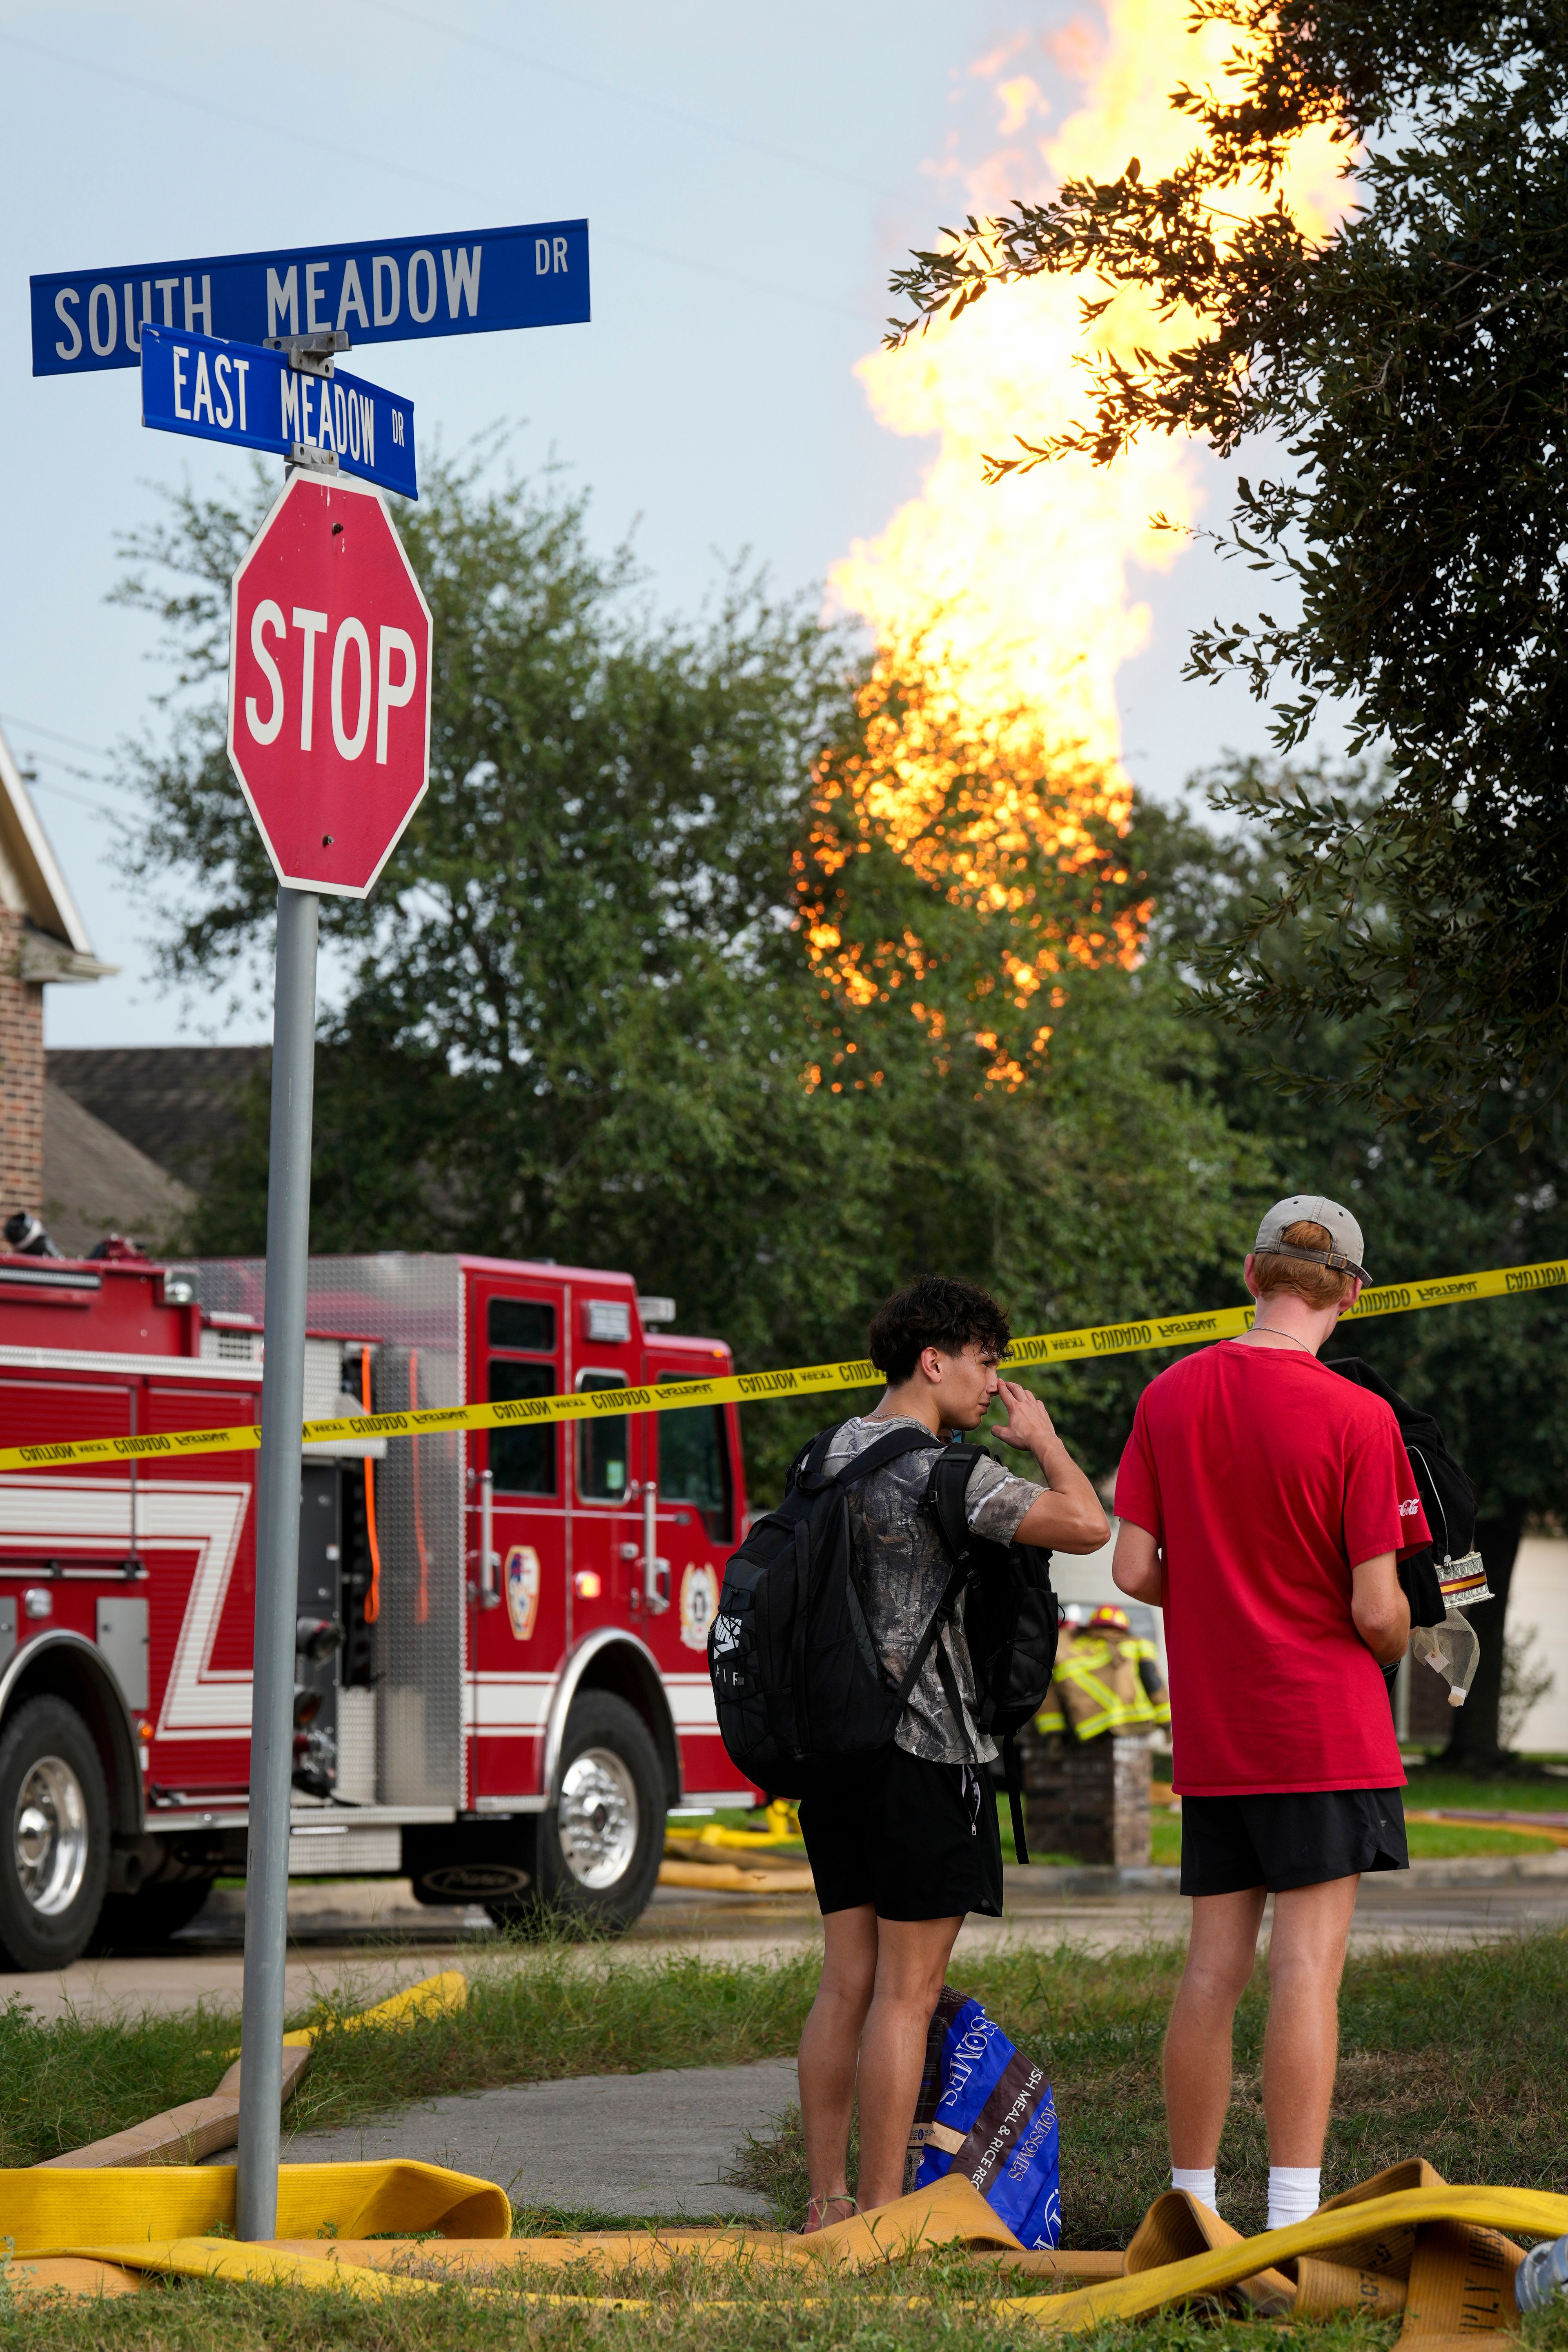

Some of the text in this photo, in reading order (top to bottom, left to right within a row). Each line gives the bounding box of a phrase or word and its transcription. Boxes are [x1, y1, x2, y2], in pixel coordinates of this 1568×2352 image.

[54, 237, 569, 360] SOUTH MEADOW DR
[173, 345, 405, 467] EAST MEADOW DR
[245, 599, 416, 765] STOP
[998, 2125, 1011, 2136] &
[1004, 2089, 1032, 2123] MEAL
[980, 2136, 1004, 2169] RICE
